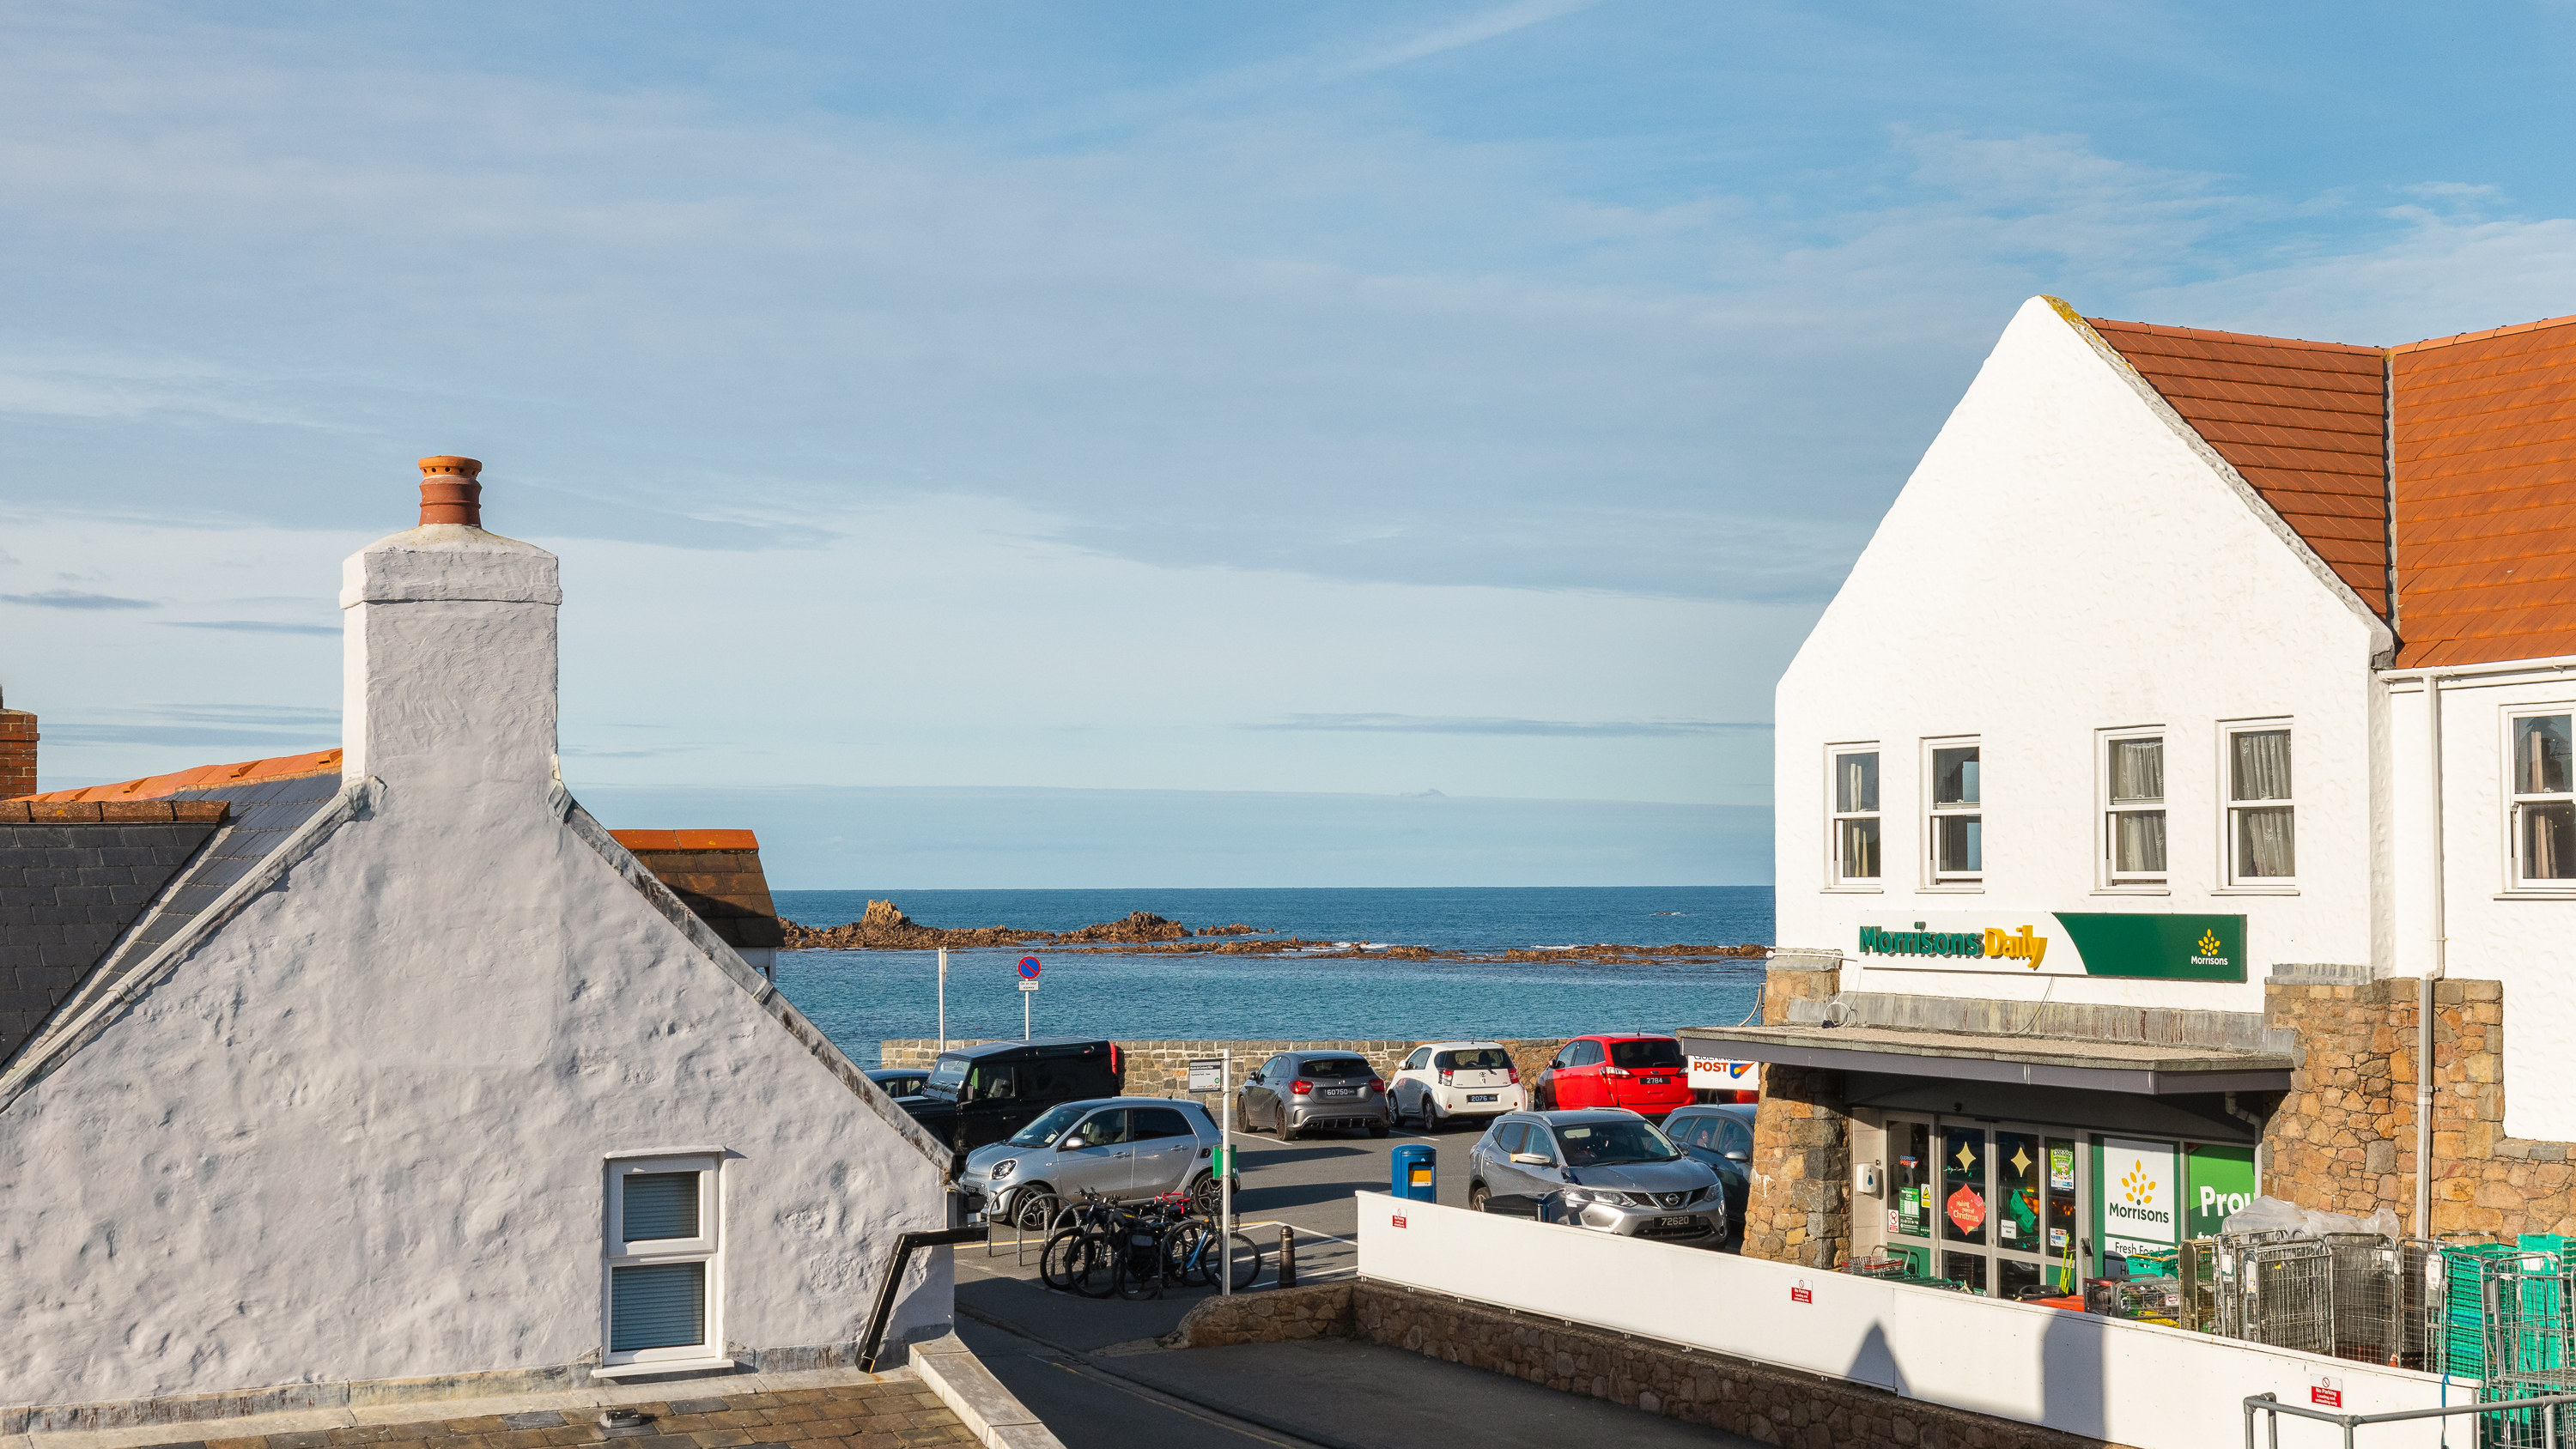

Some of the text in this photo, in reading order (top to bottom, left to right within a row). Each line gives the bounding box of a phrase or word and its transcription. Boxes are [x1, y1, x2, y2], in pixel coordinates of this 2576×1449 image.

[1859, 921, 2048, 971] Morrisons Daily
[2190, 953, 2228, 966] Morrisons
[1693, 1061, 1728, 1072] POST
[1956, 1200, 1971, 1209] Making
[2109, 1199, 2170, 1224] Morrisons
[1662, 1216, 1689, 1226] 72620
[2115, 1241, 2137, 1255] Fresh
[2322, 1388, 2336, 1397] Parking
